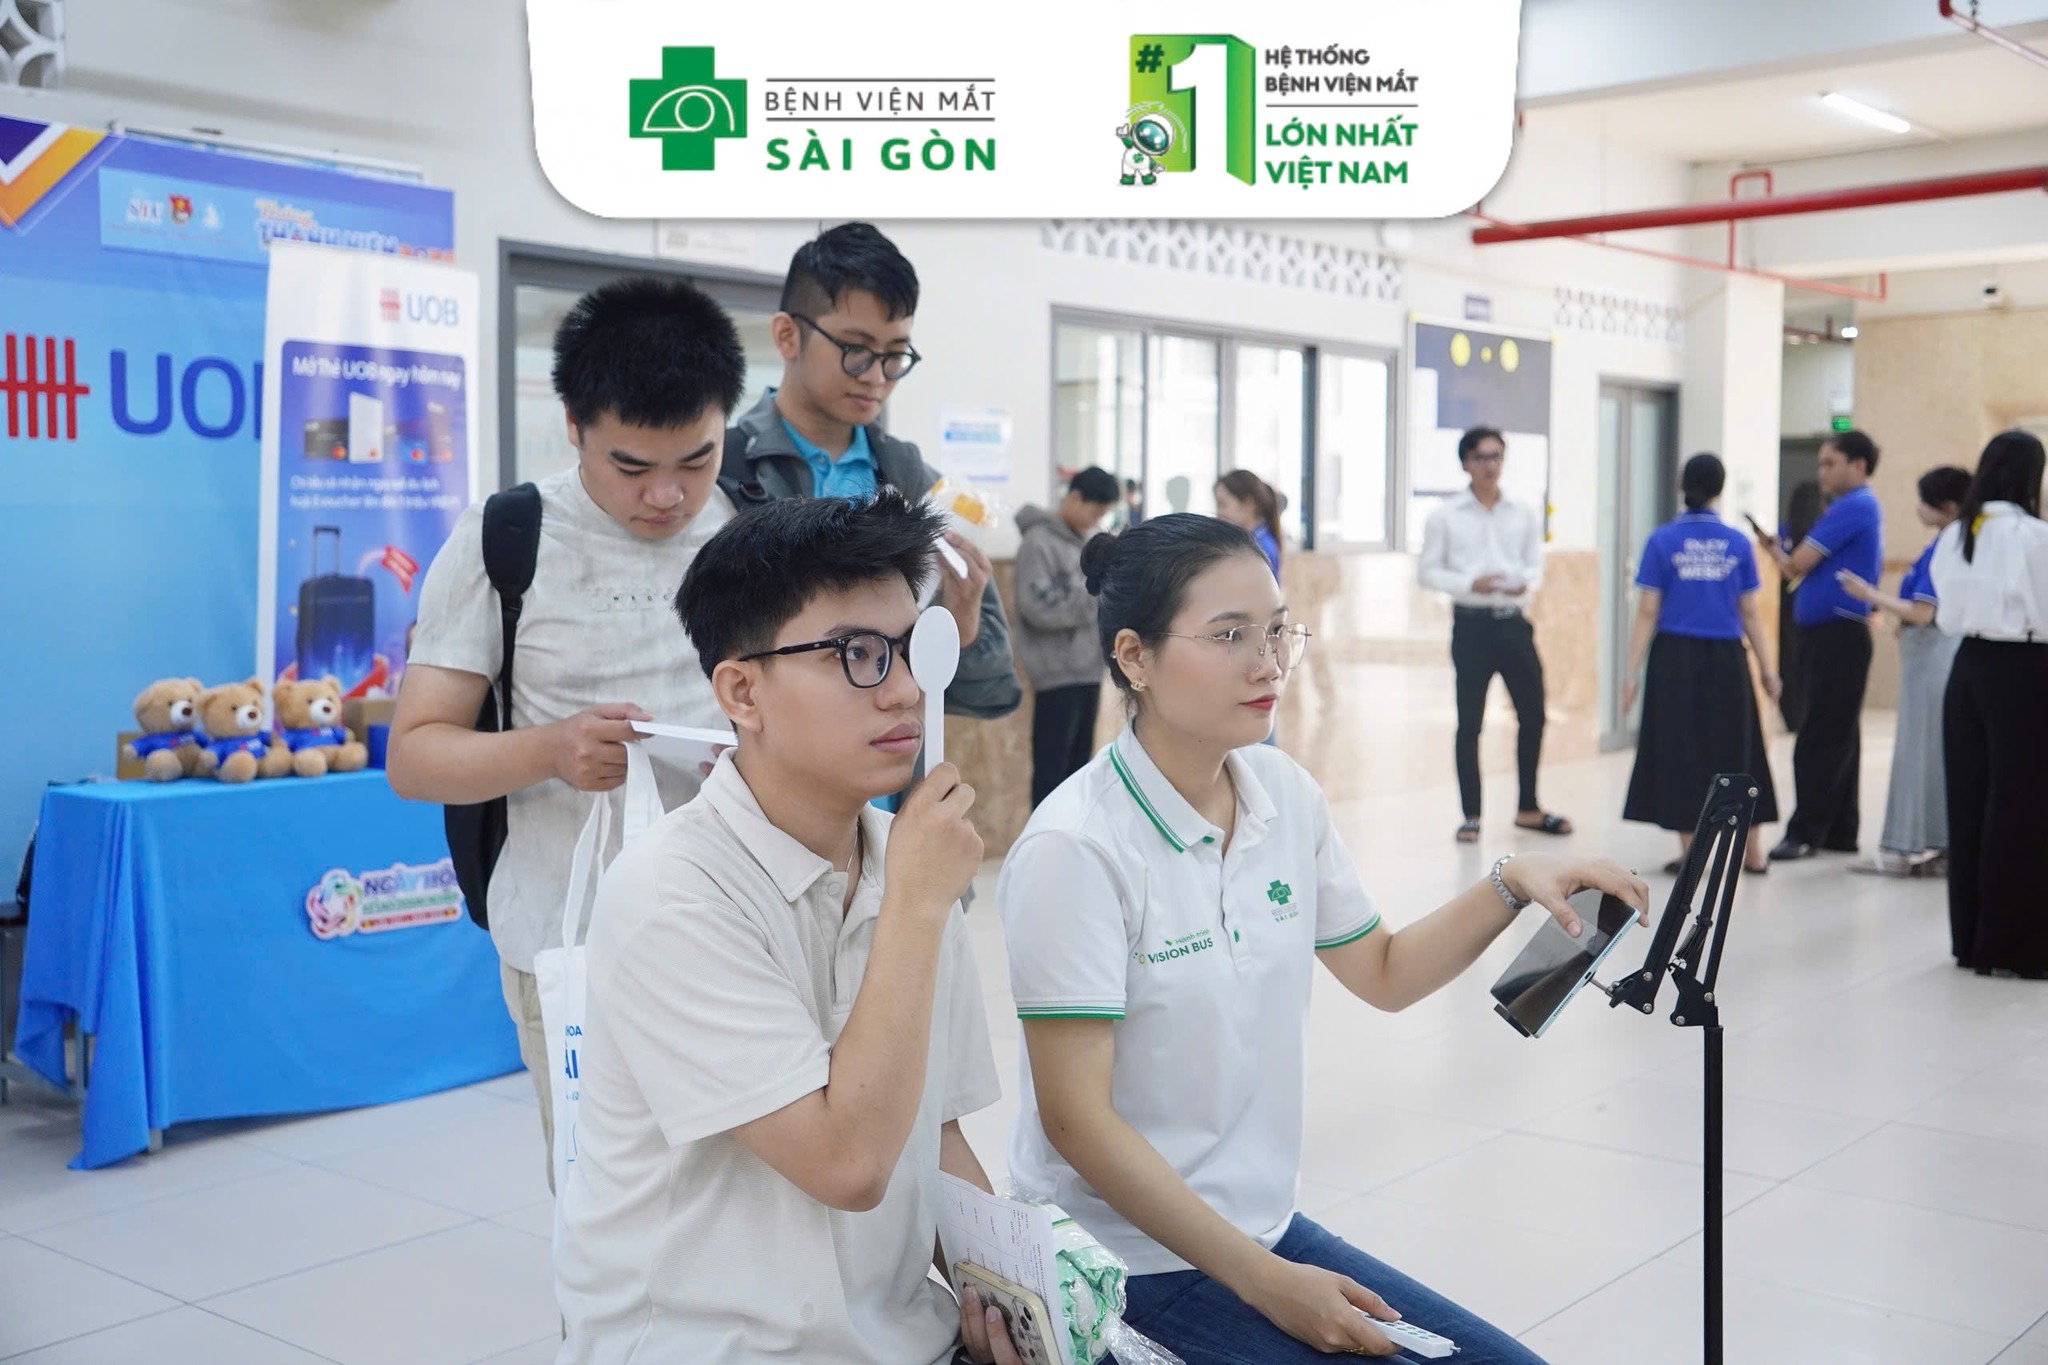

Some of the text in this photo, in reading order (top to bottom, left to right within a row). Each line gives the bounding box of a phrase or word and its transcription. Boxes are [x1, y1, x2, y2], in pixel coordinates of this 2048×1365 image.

[406, 293, 459, 326] UOB
[342, 359, 378, 381] UOB
[109, 347, 262, 440] UO
[1147, 937, 1214, 964] VISION BUS
